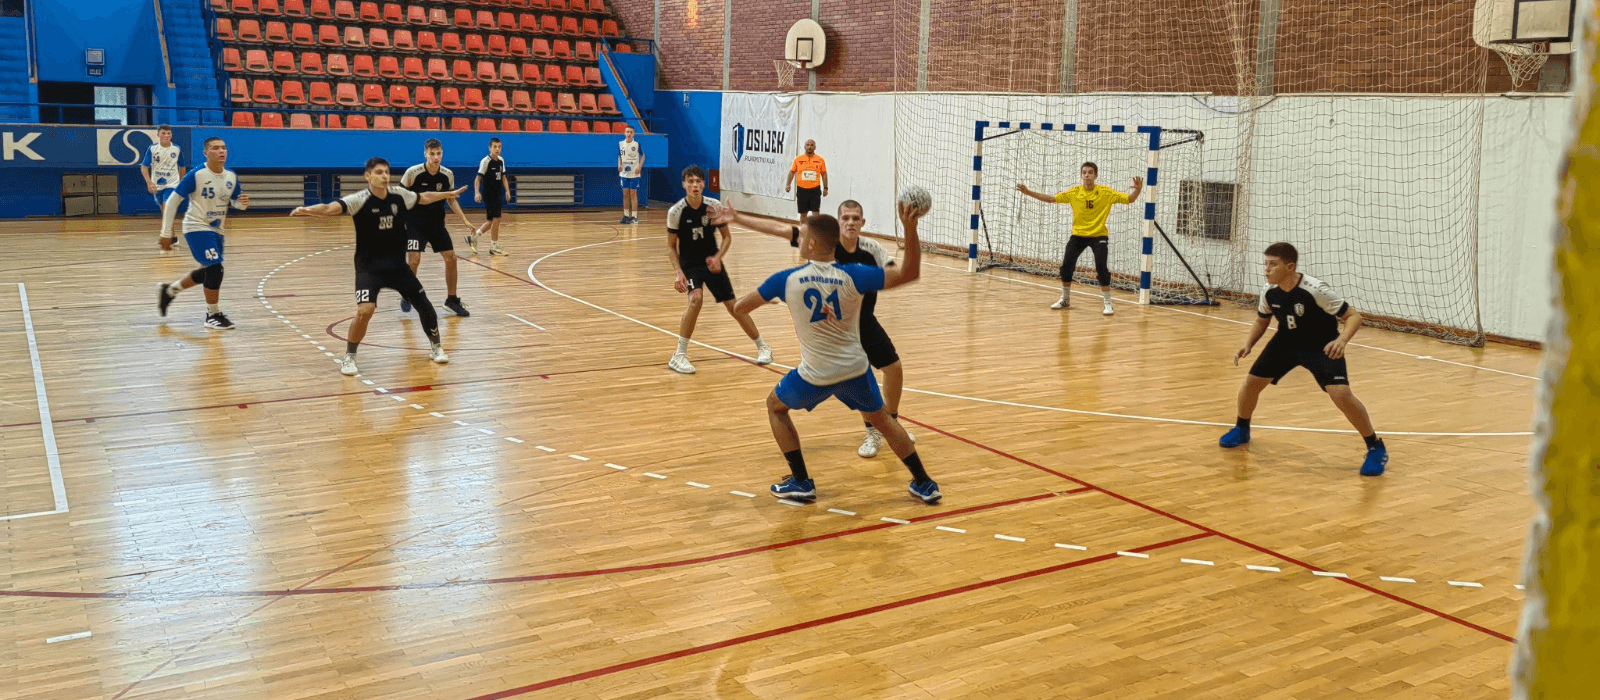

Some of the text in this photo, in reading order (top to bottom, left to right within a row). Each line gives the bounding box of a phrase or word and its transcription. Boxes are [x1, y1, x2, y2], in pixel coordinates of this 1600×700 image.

[2, 131, 46, 161] K
[745, 129, 785, 154] OSIJEK
[201, 186, 216, 199] 45
[1085, 200, 1094, 209] 16
[407, 239, 420, 251] 20
[205, 248, 219, 260] 45
[356, 289, 370, 303] 22
[803, 287, 843, 324] 21
[1286, 314, 1298, 330] 8
